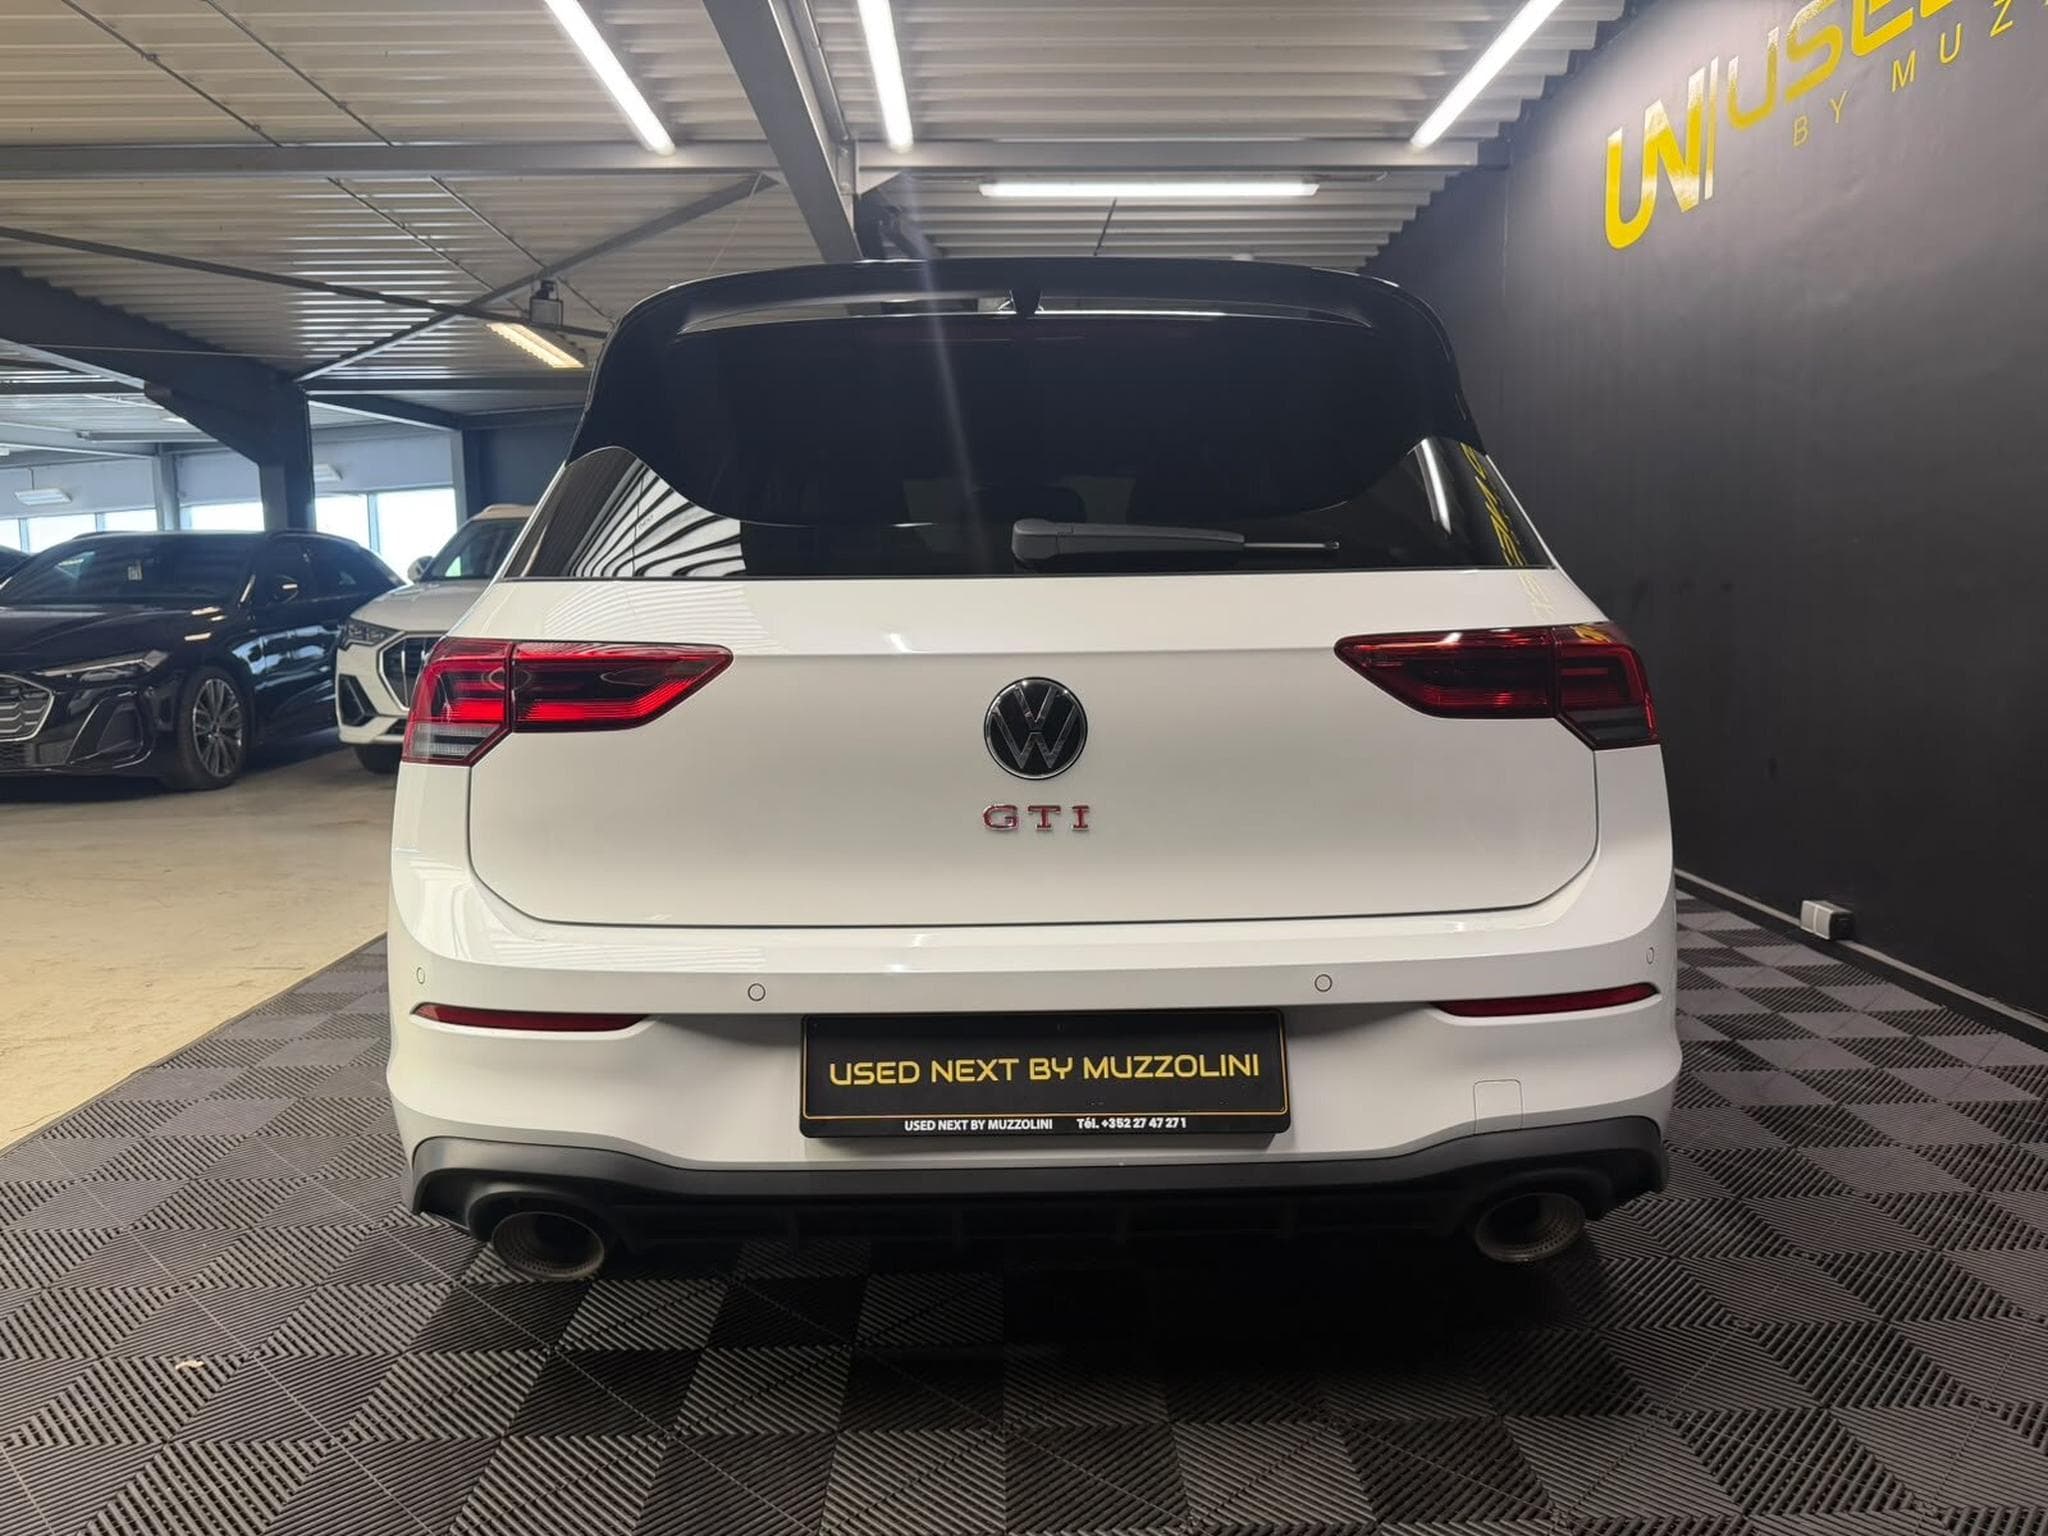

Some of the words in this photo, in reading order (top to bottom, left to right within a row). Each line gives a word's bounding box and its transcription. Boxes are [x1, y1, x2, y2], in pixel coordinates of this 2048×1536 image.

[1727, 0, 1956, 130] USE
[1792, 90, 1848, 147] BY
[1891, 0, 2048, 93] MUZ
[989, 682, 1081, 770] VW
[982, 804, 1091, 831] GTI
[830, 1061, 920, 1086] USED
[931, 1058, 1019, 1083] NEXT
[1029, 1056, 1073, 1081] BY
[1083, 1054, 1260, 1080] MUZZOLINI
[904, 1120, 936, 1131] USED
[938, 1119, 968, 1131] NEXT
[970, 1119, 986, 1131] BY
[988, 1118, 1053, 1130] MUZZOLINI
[1076, 1117, 1099, 1130] Tél.
[1101, 1118, 1132, 1129] +352
[1132, 1118, 1147, 1129] 27
[1149, 1118, 1164, 1129] 47
[1165, 1117, 1187, 1129] 271
